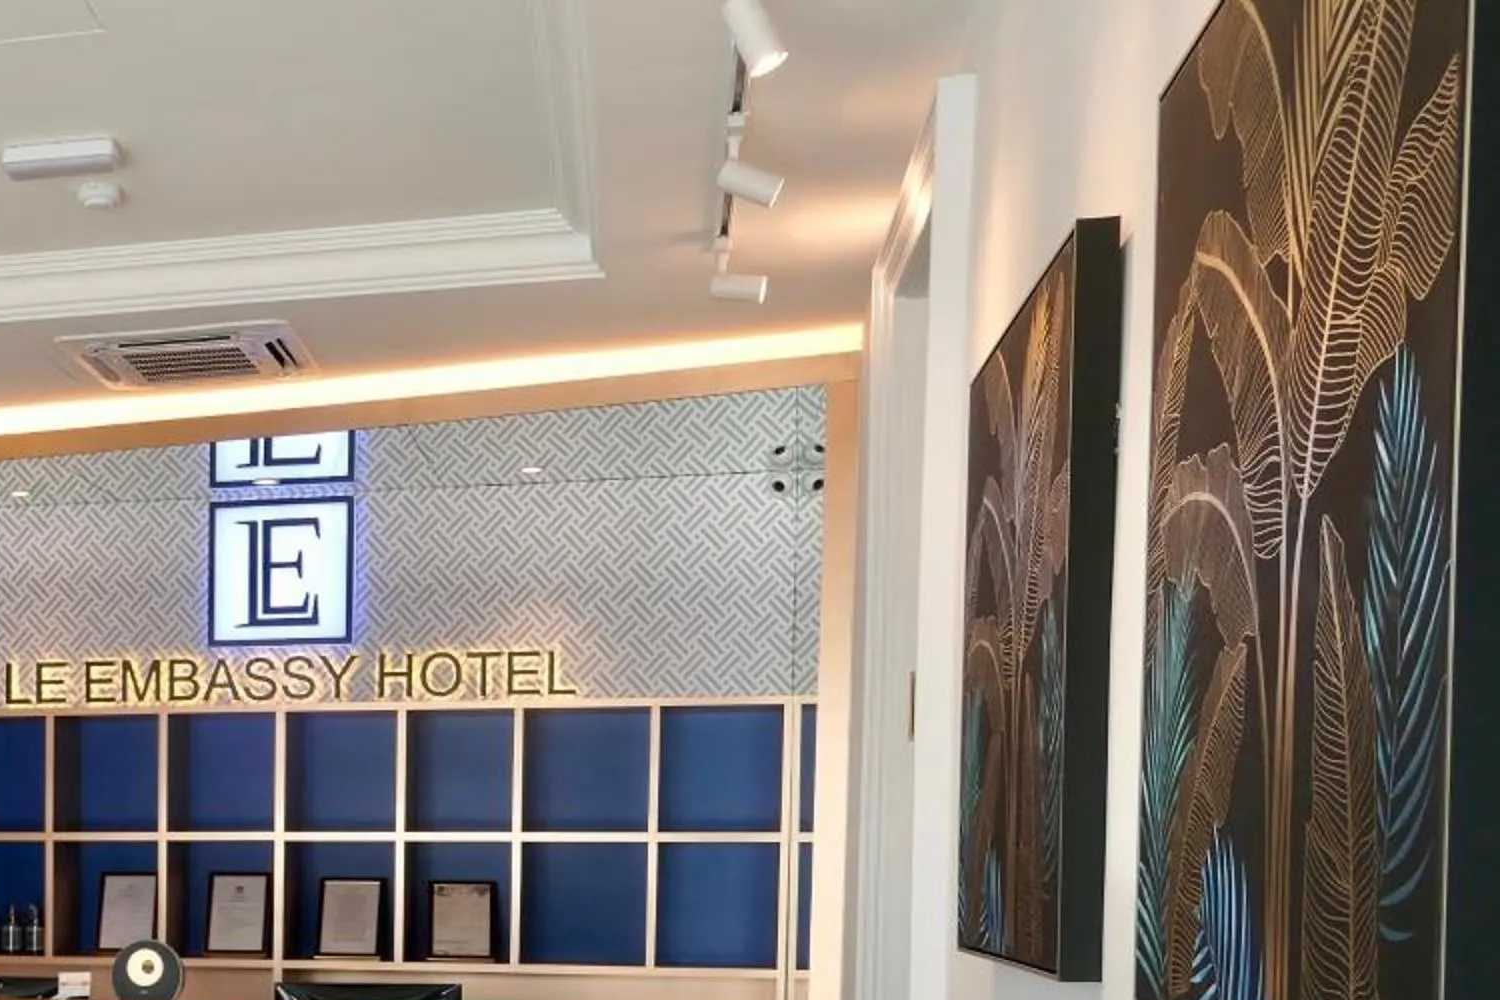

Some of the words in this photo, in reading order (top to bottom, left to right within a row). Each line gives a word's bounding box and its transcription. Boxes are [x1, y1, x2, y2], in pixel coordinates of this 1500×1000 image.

[4, 660, 68, 705] LE
[84, 655, 357, 703] EMBASSY
[377, 650, 577, 698] HOTEL
